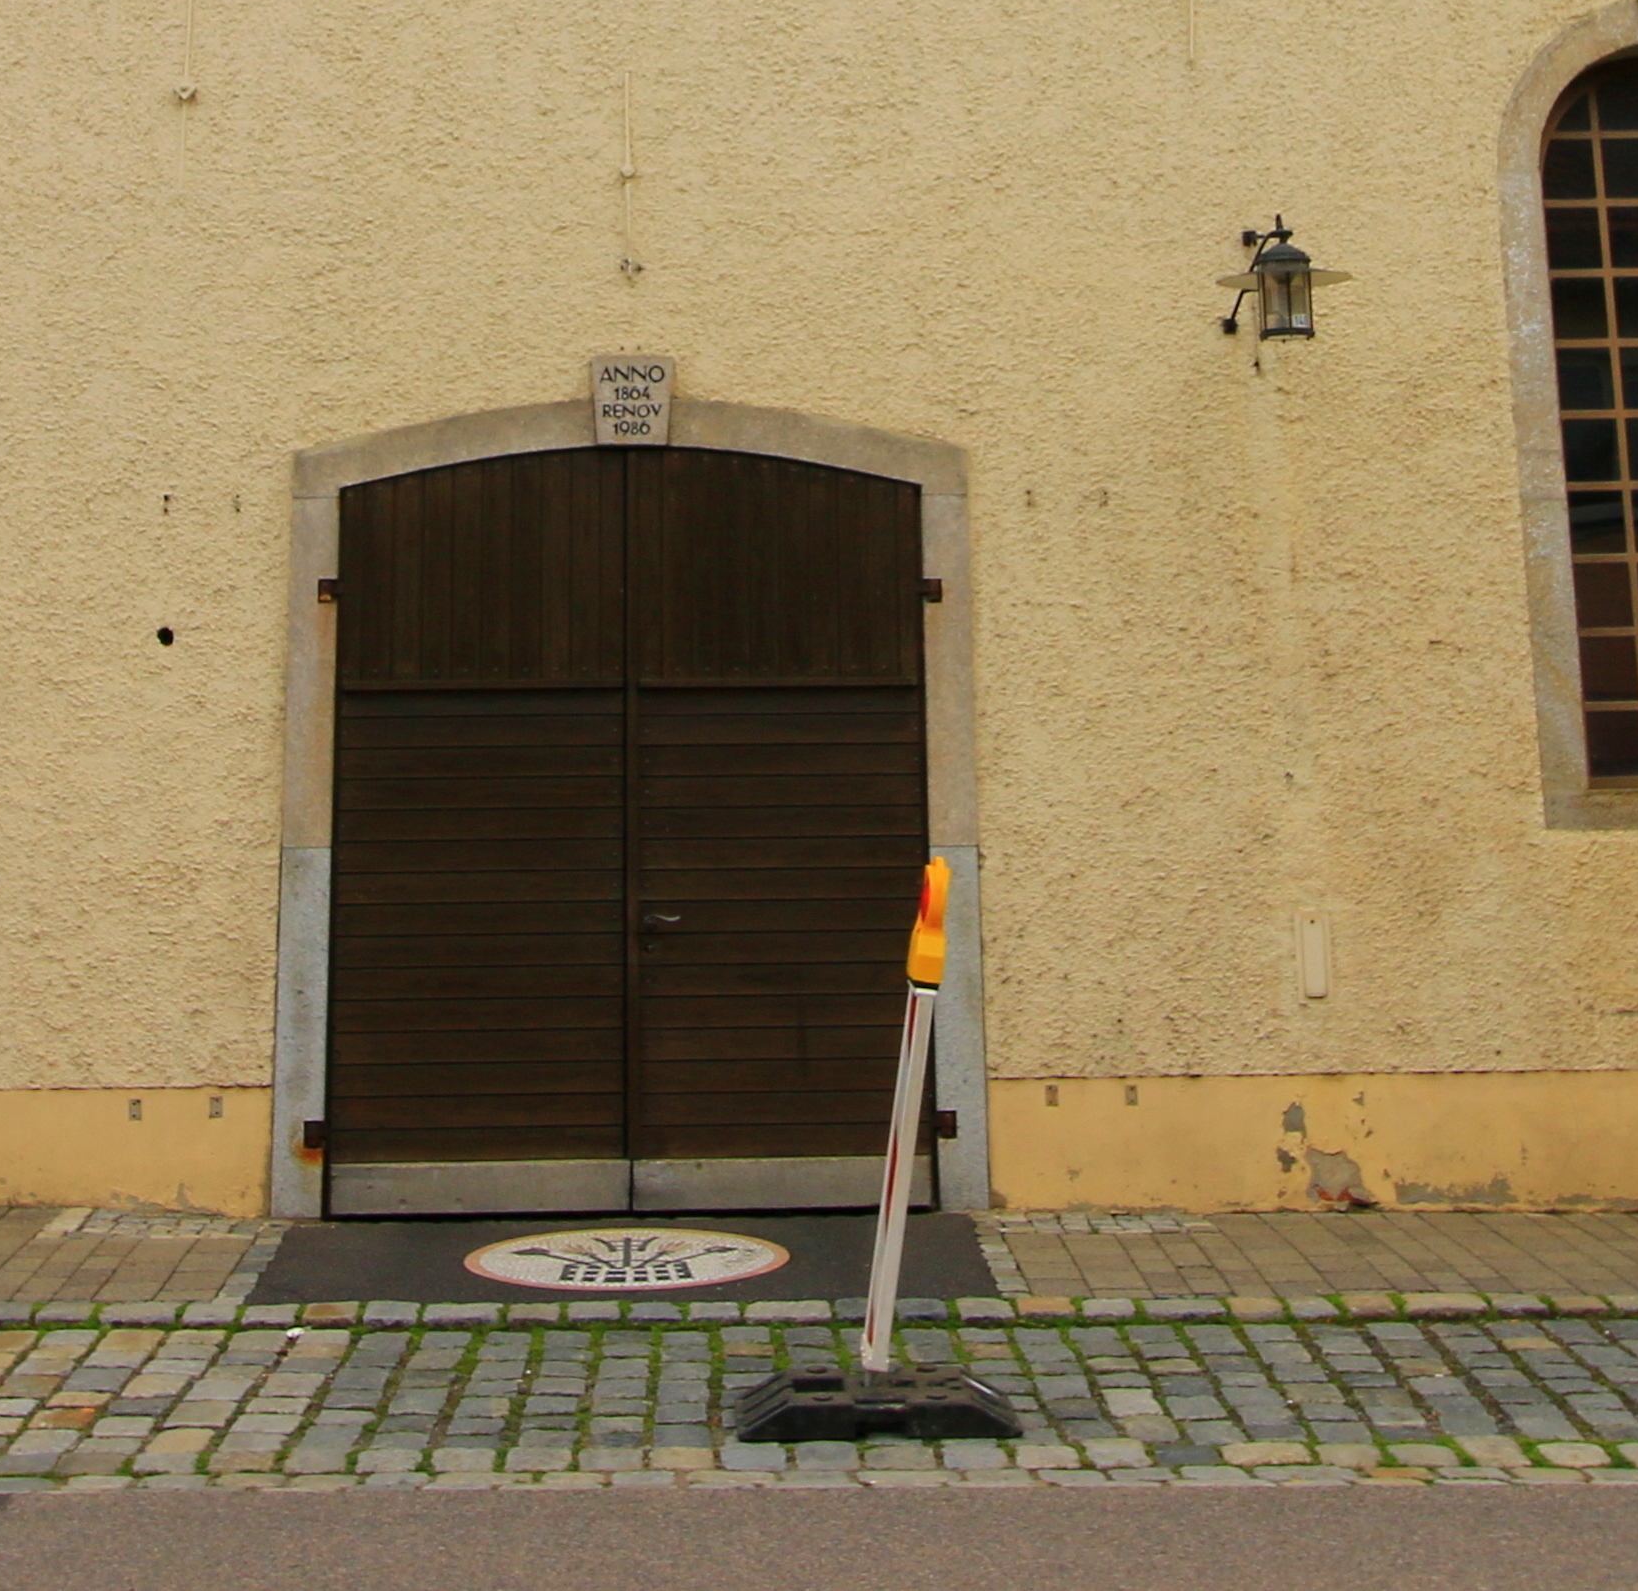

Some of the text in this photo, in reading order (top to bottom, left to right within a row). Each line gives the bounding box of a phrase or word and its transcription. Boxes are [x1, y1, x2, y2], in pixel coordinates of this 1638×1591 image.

[600, 365, 665, 383] ANNO
[614, 386, 650, 400] 1864
[602, 404, 662, 418] RENOV
[613, 420, 650, 436] 1986
